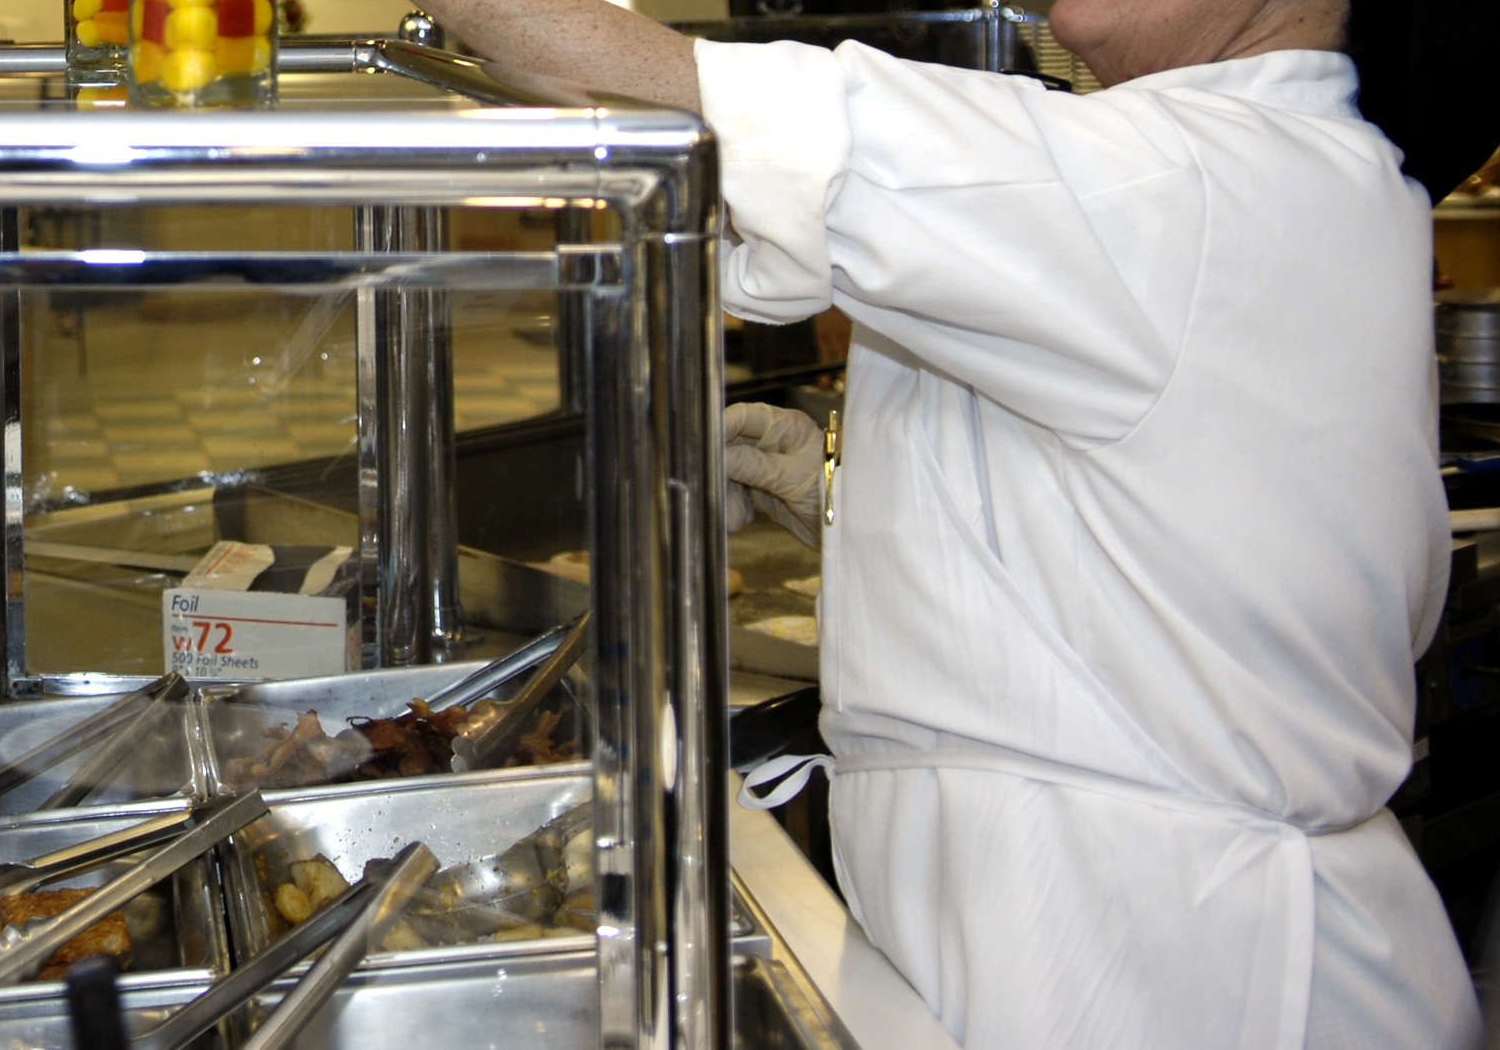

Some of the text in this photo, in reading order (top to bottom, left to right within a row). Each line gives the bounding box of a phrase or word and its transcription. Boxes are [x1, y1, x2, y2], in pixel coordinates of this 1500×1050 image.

[171, 595, 200, 612] Foil
[172, 653, 259, 669] 500 Foil Sheets
